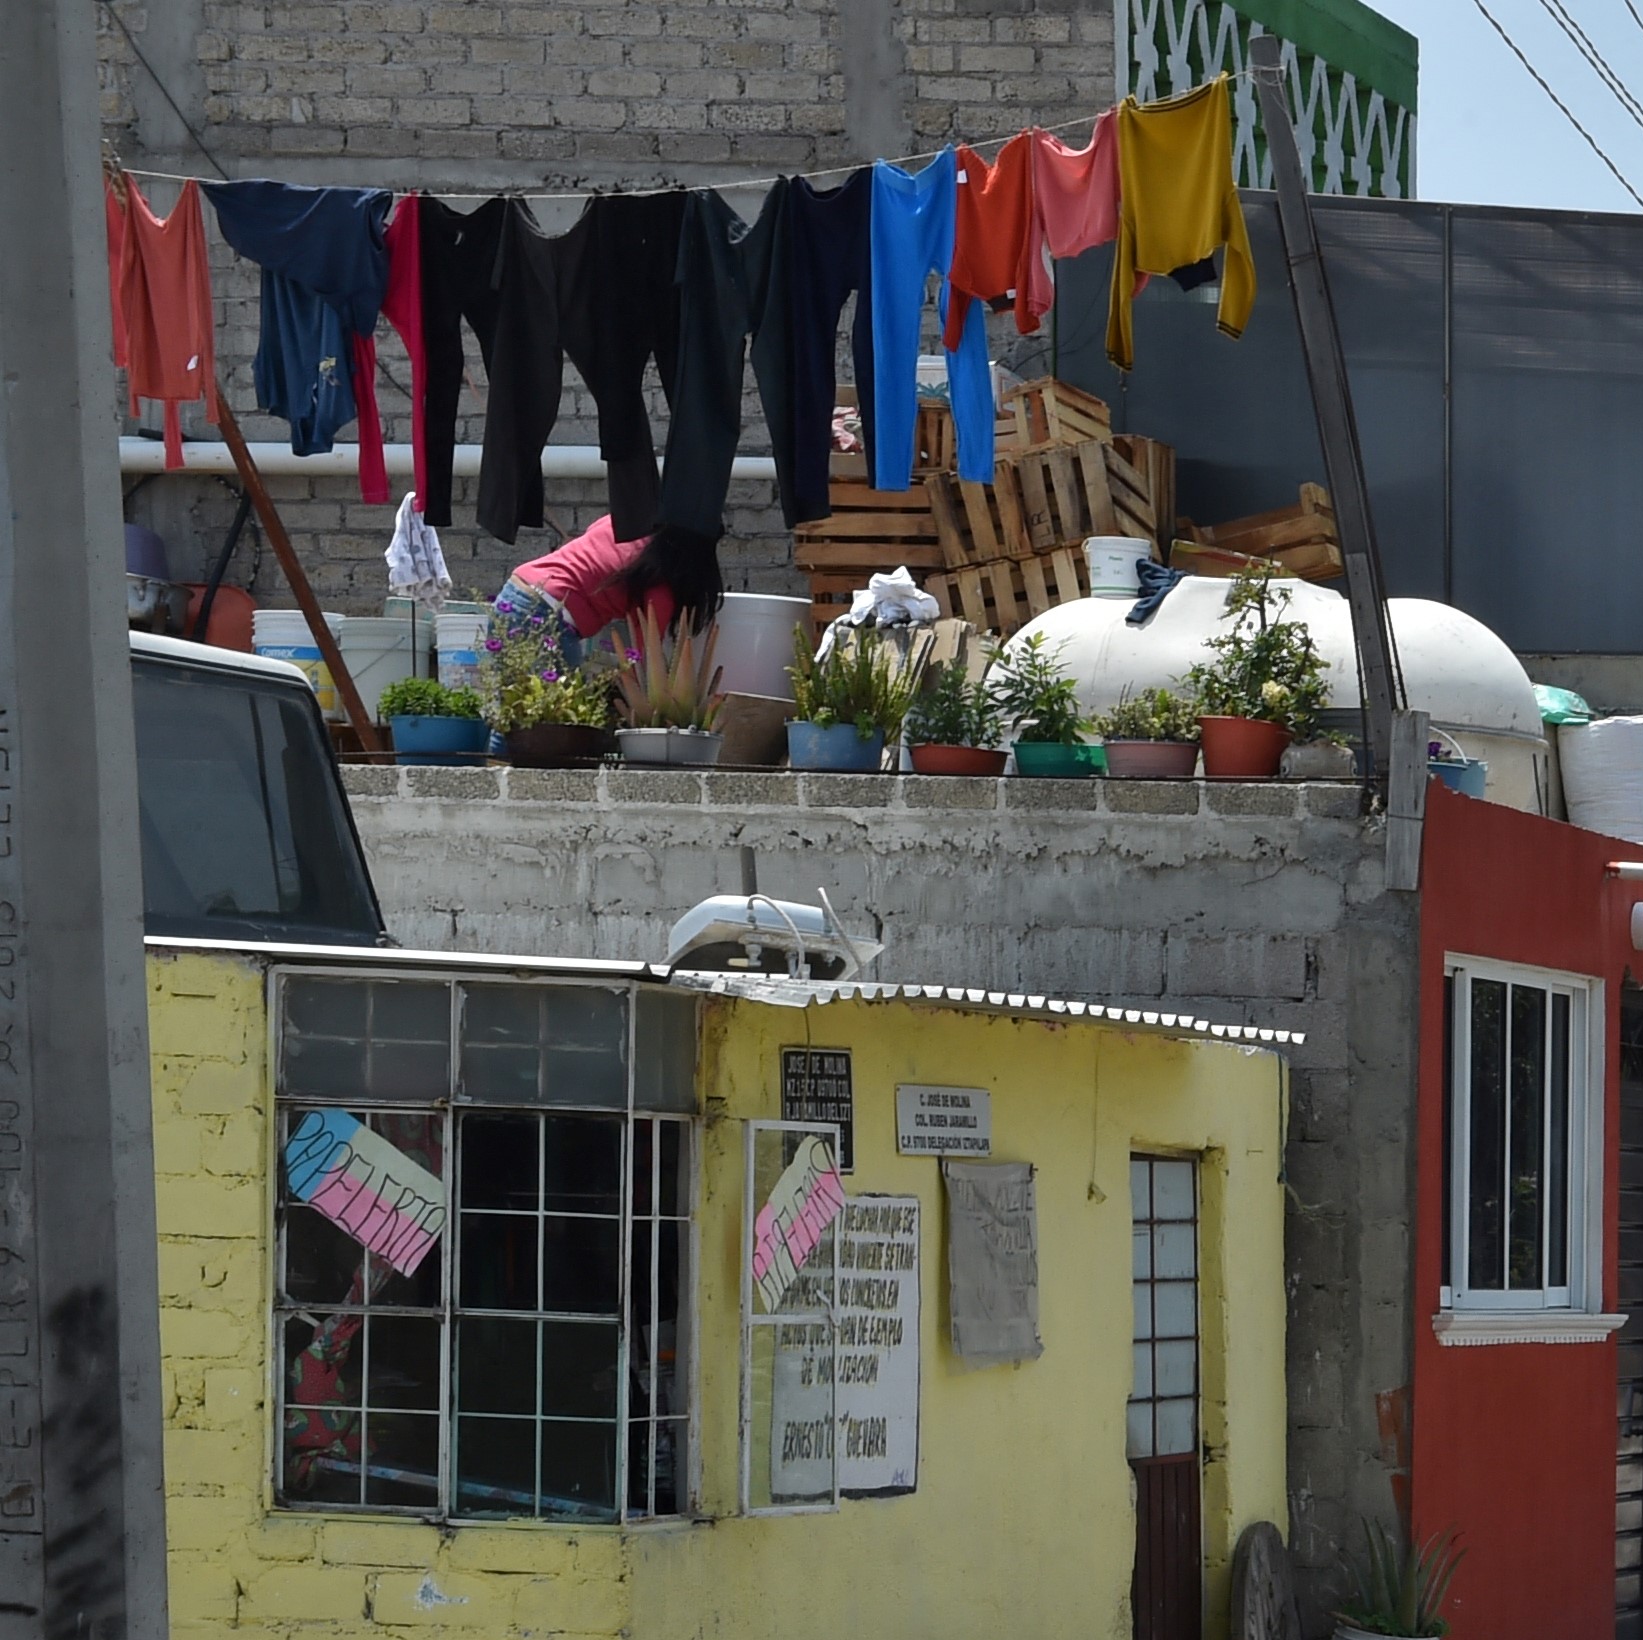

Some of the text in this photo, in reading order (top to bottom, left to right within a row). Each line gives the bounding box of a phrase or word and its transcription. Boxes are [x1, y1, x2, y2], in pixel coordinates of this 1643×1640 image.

[811, 1055, 821, 1074] DE
[941, 1094, 950, 1108] DE
[950, 1095, 971, 1108] MOLINA
[285, 1111, 447, 1274] PAPELERIA
[857, 1315, 868, 1346] DE
[847, 1416, 887, 1458] GUEVARA
